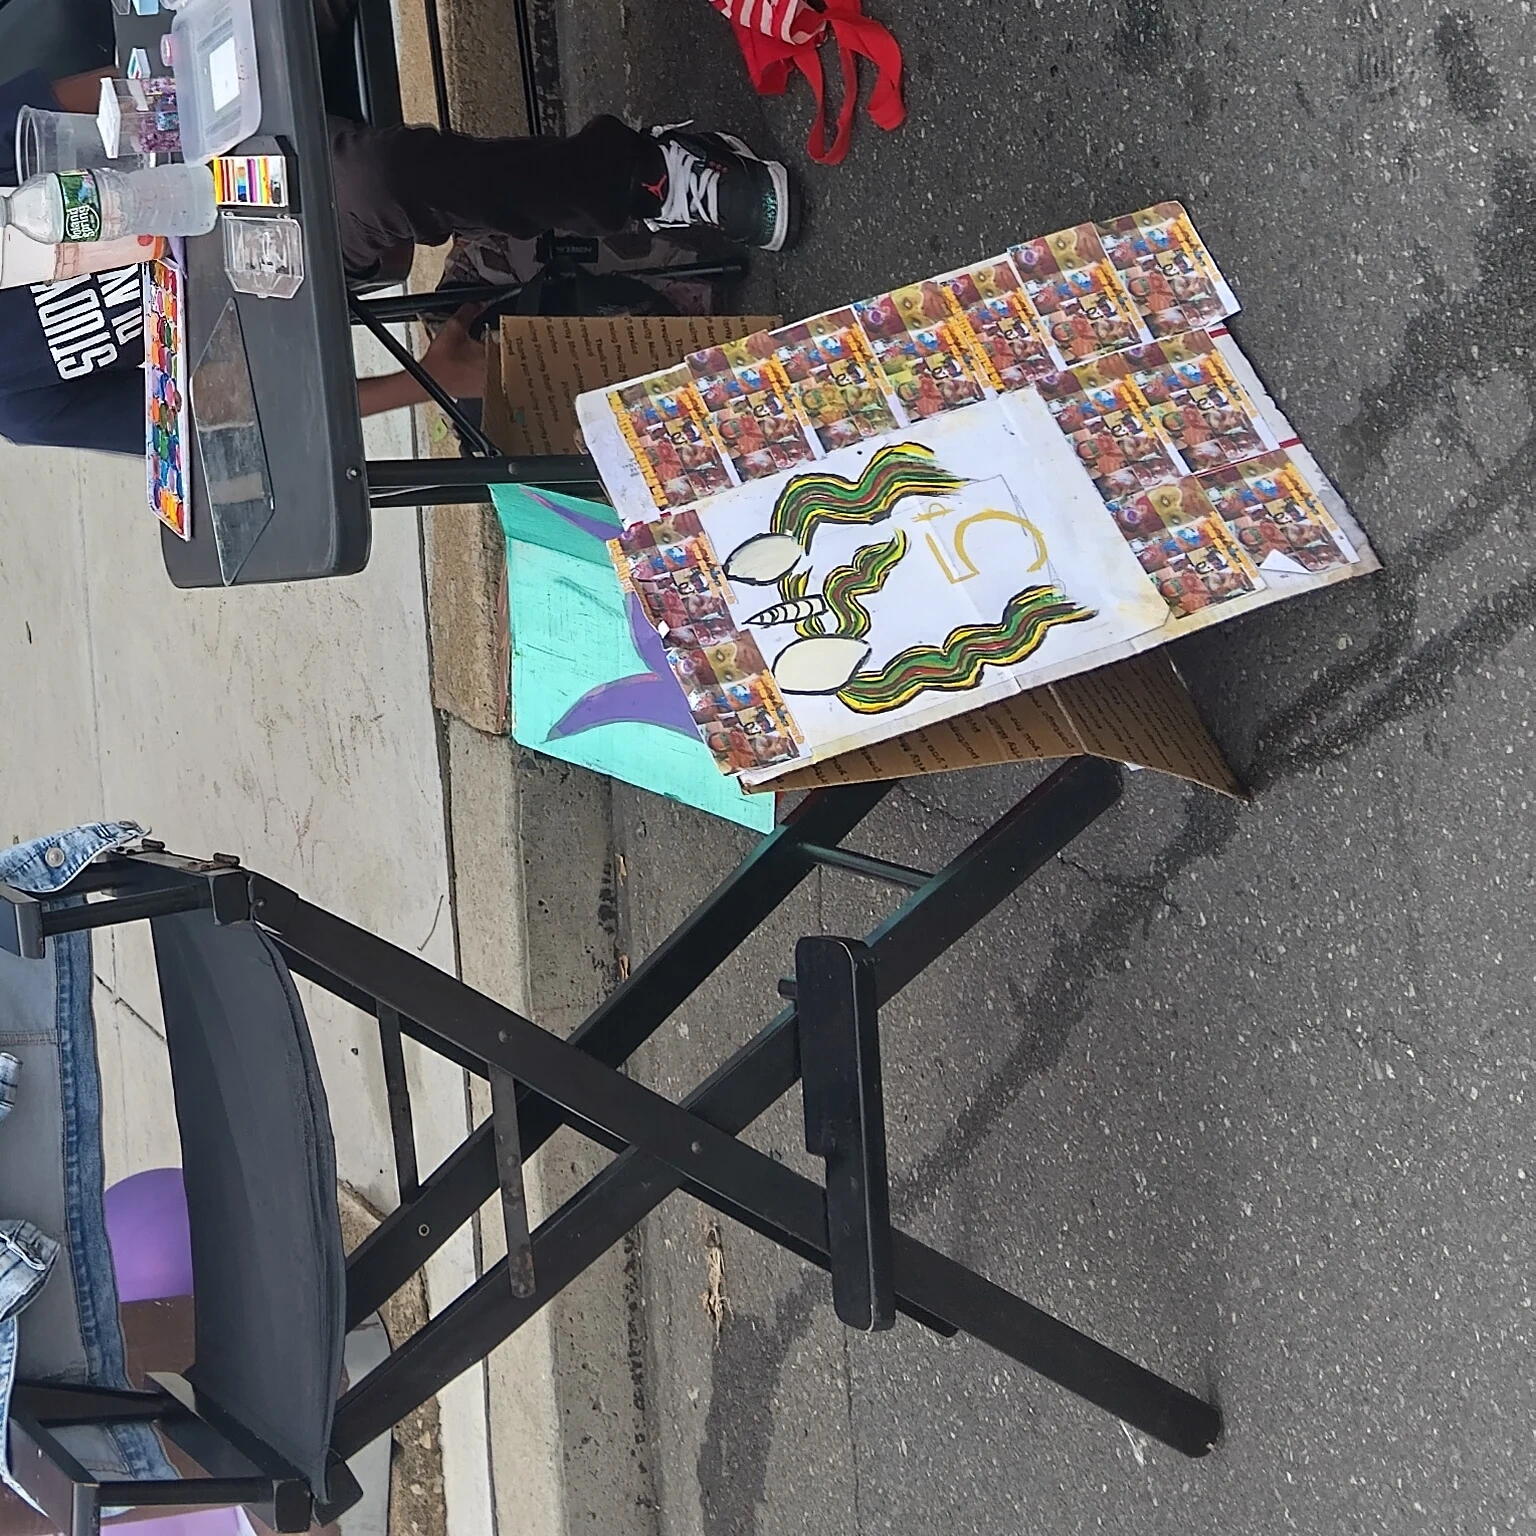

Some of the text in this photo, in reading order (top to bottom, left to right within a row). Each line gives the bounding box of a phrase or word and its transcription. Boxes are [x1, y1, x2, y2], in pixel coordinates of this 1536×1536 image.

[66, 208, 83, 239] Poland
[78, 204, 95, 237] Spring
[30, 274, 118, 379] STUDY
